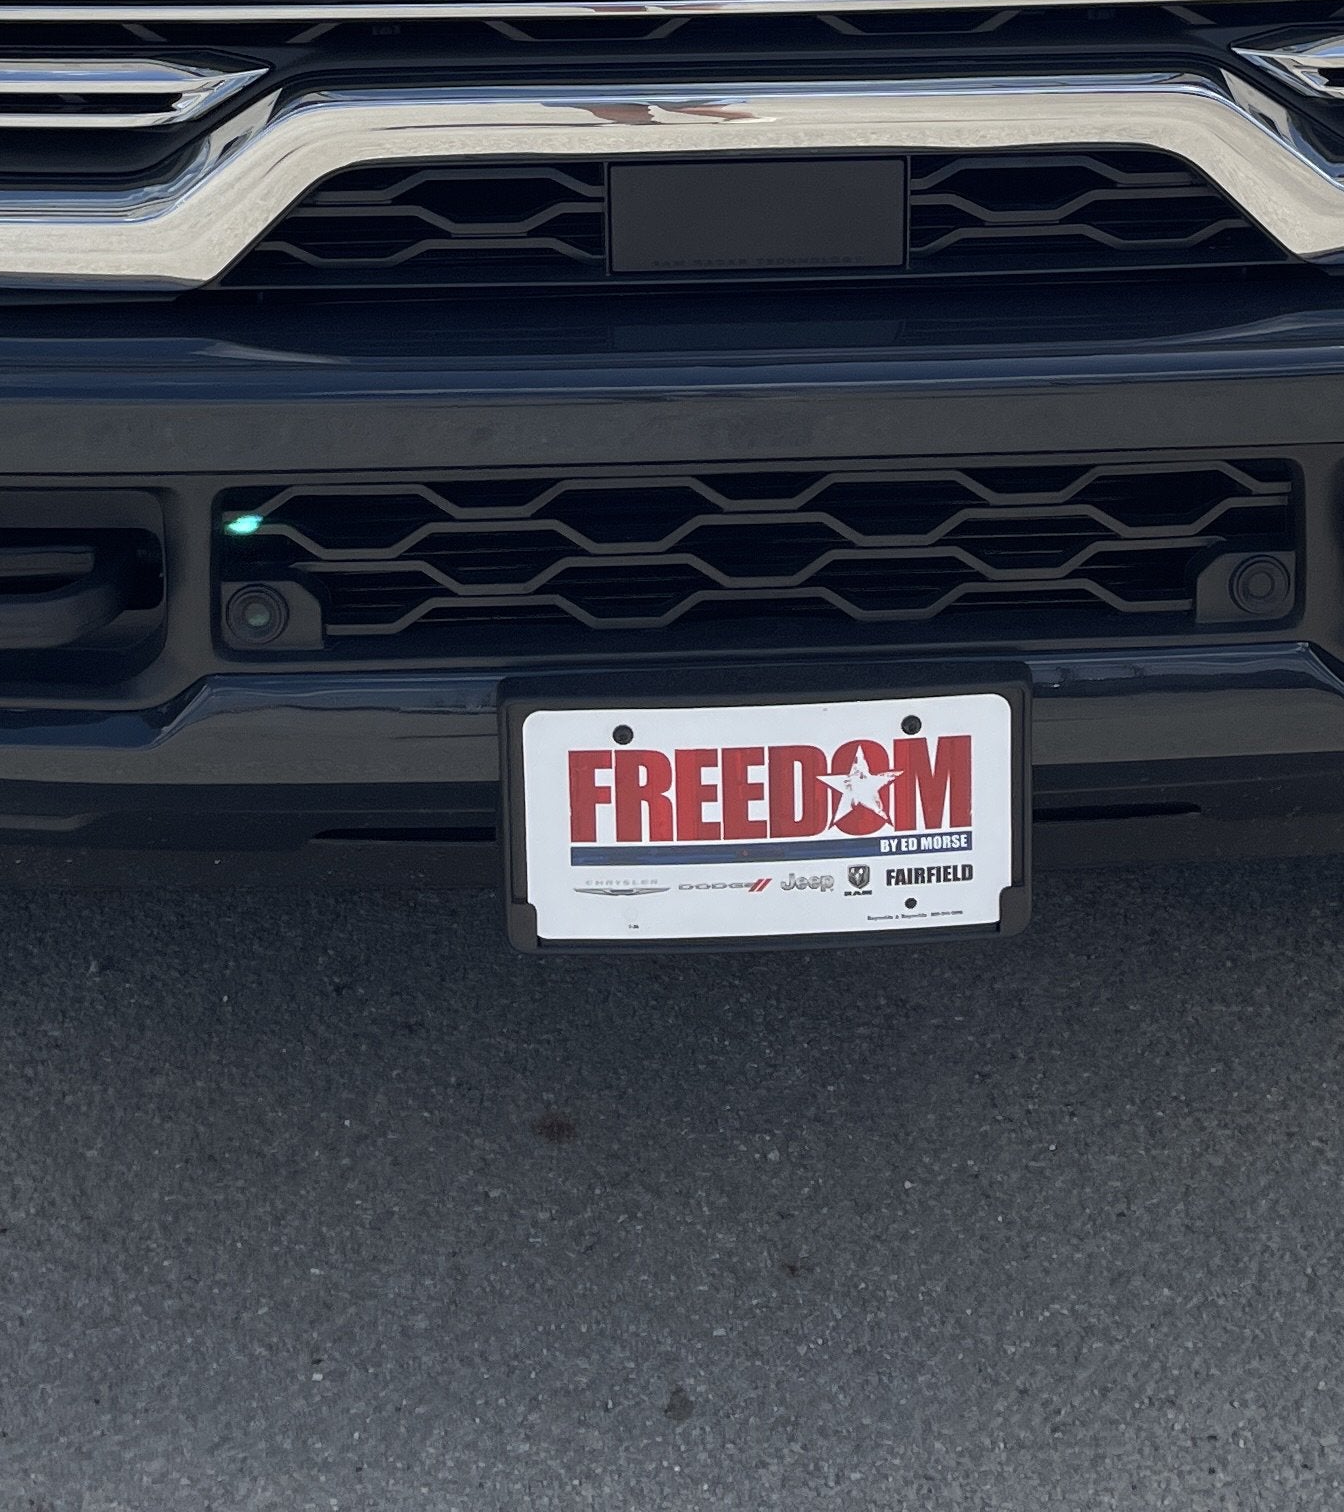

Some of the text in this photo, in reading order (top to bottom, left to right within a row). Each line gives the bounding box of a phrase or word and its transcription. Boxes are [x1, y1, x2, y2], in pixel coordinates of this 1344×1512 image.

[568, 735, 973, 843] FREEDOM
[880, 834, 968, 853] BY ED MORSE
[780, 872, 835, 892] Jeep
[886, 864, 974, 887] FAIRFIELD
